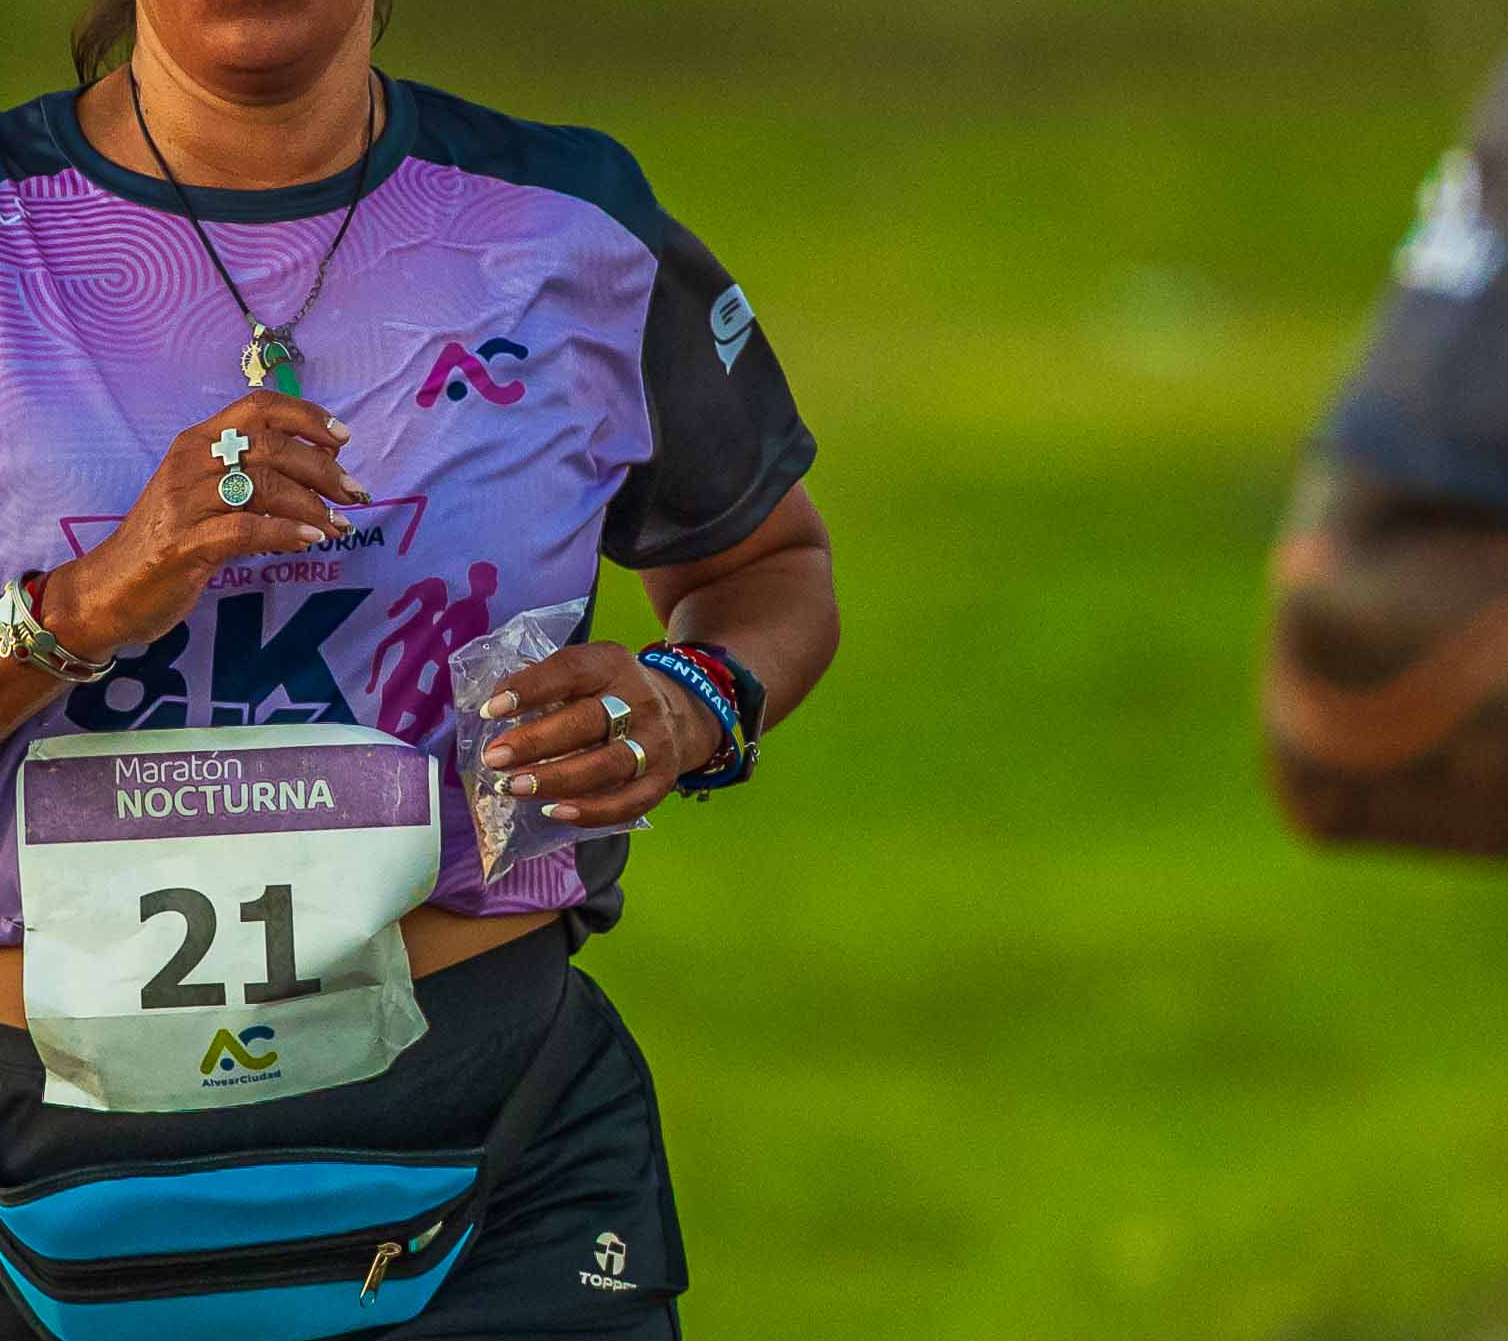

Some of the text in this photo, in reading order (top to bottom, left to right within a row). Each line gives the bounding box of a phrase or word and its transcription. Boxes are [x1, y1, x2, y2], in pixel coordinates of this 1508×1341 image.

[261, 560, 342, 584] CORRE
[644, 653, 729, 722] CENTRAL
[115, 751, 242, 785] Maratón
[116, 778, 335, 820] NOCTURNA
[139, 883, 321, 1009] 21
